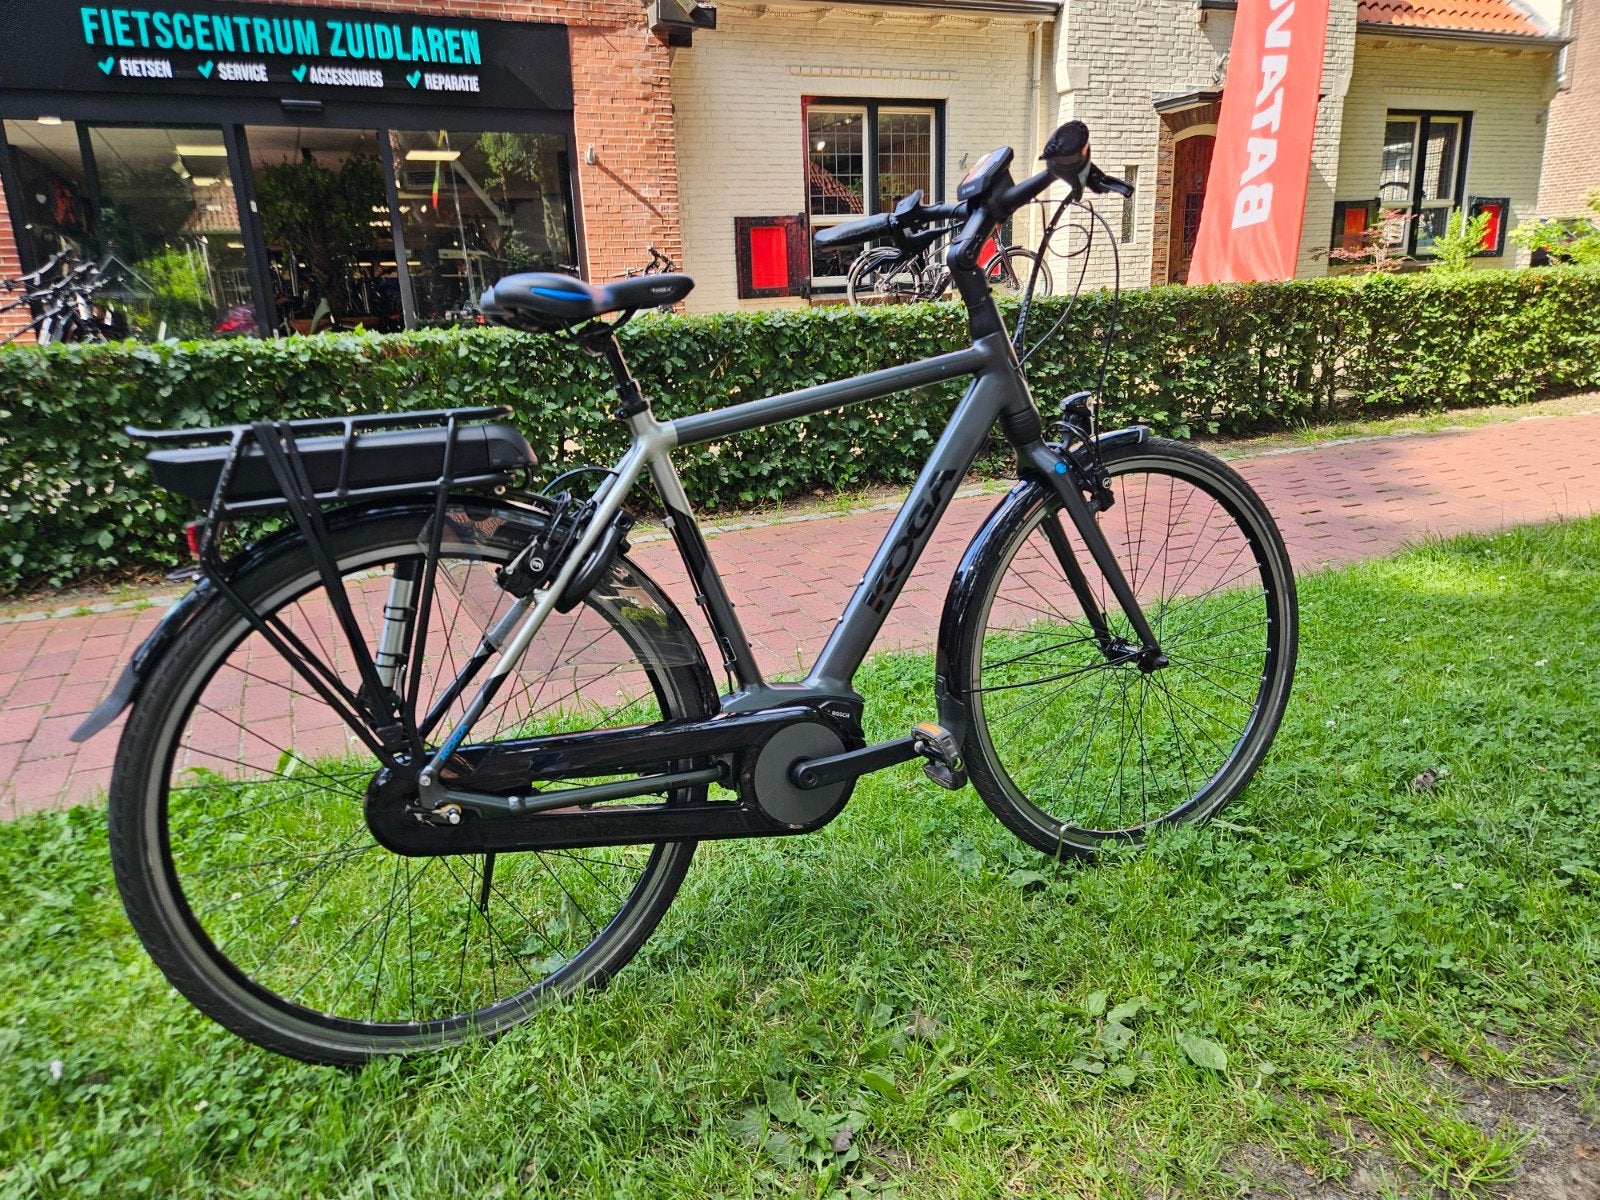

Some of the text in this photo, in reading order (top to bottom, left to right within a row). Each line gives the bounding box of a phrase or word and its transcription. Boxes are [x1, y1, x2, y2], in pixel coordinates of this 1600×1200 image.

[81, 7, 482, 65] FIETSCENTRUM ZUIDLAREN
[119, 57, 173, 79] FIETSEN
[217, 61, 269, 82] SERVICE
[310, 65, 384, 88] ACCESSOIRES
[424, 72, 480, 93] REPARATIE
[863, 469, 957, 614] KOGA
[831, 710, 850, 719] BOSCH
